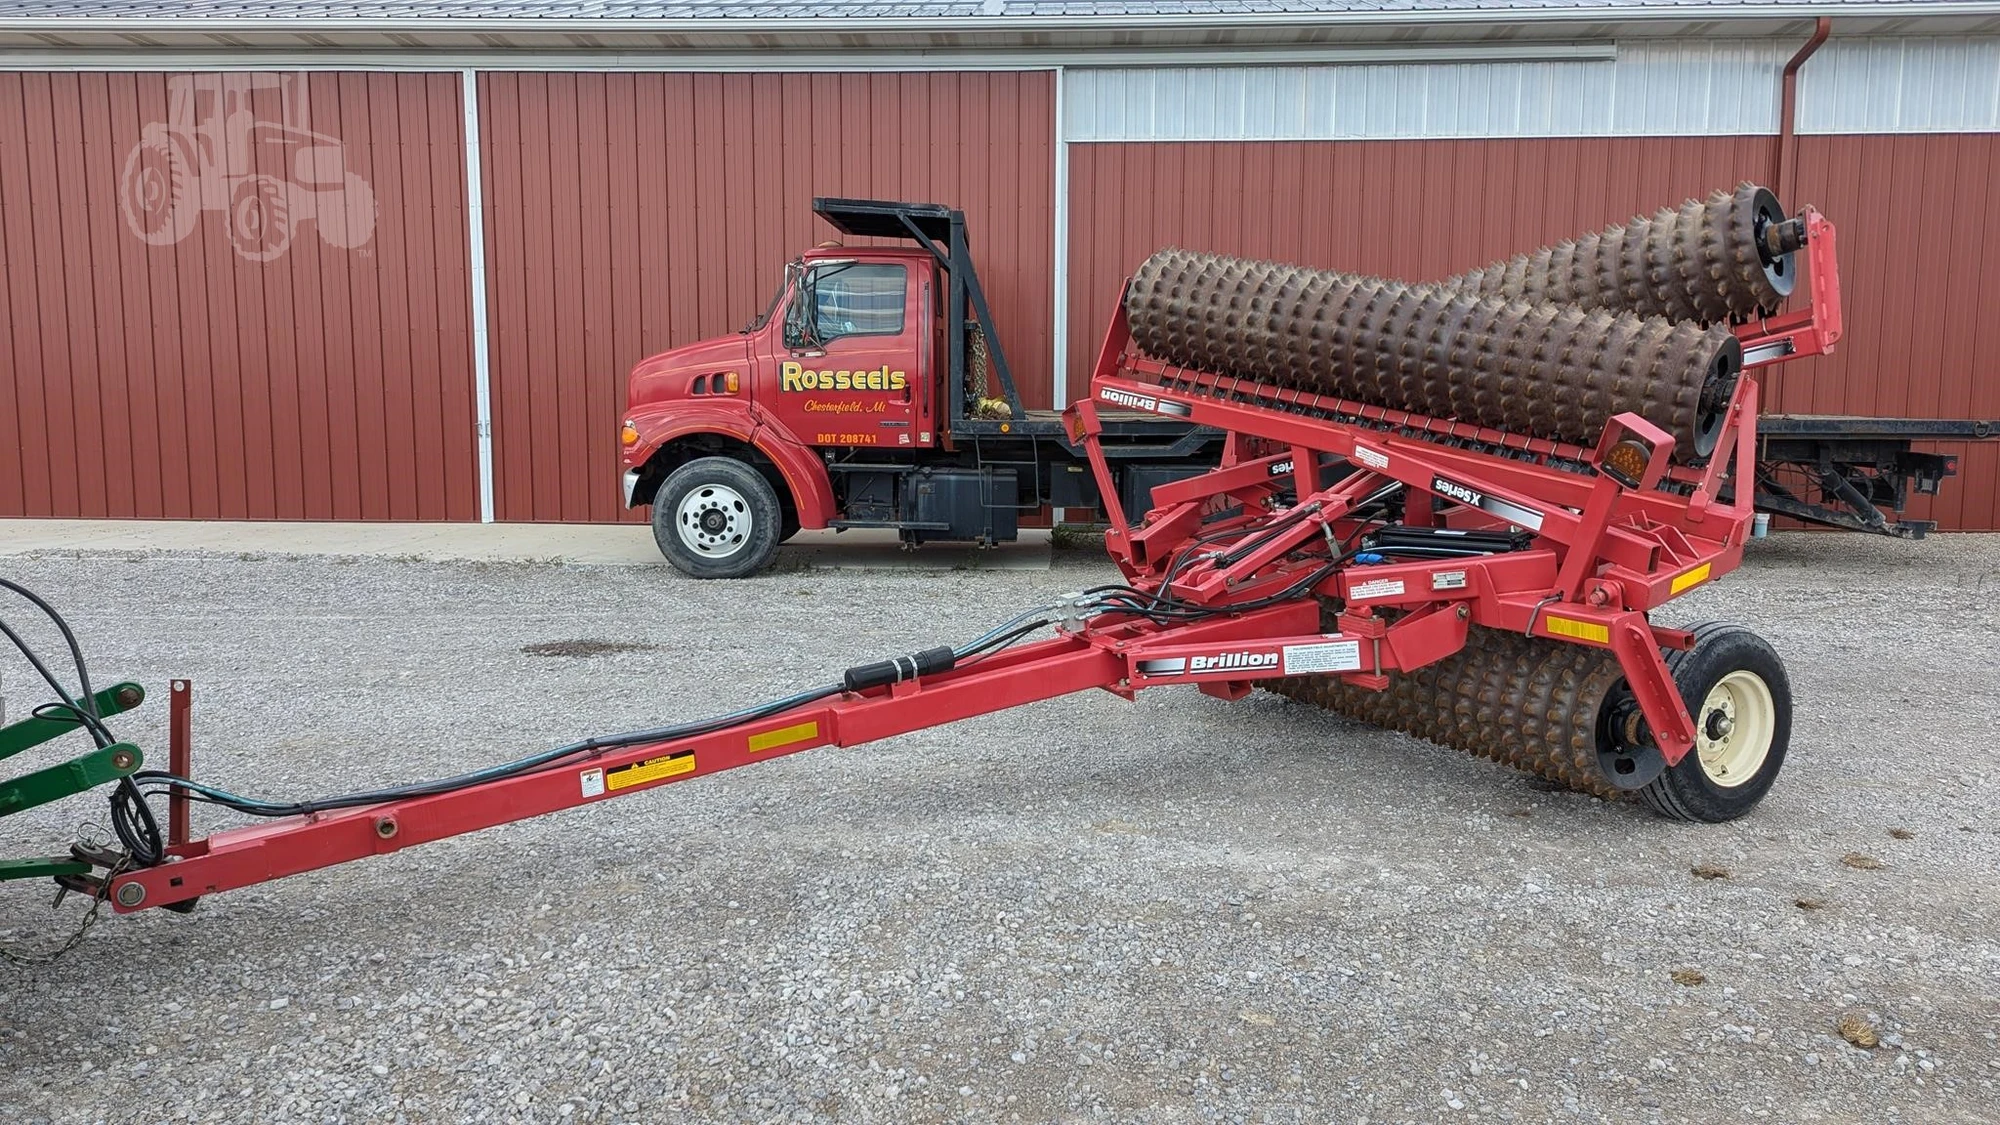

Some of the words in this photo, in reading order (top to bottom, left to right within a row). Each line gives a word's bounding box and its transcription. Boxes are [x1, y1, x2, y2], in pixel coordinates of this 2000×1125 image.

[781, 361, 906, 391] Rosseels
[1101, 389, 1156, 411] Brillion
[818, 434, 837, 444] DOT
[840, 434, 877, 444] 208741
[1189, 651, 1279, 670] Brillion
[643, 755, 671, 766] CAUTION
